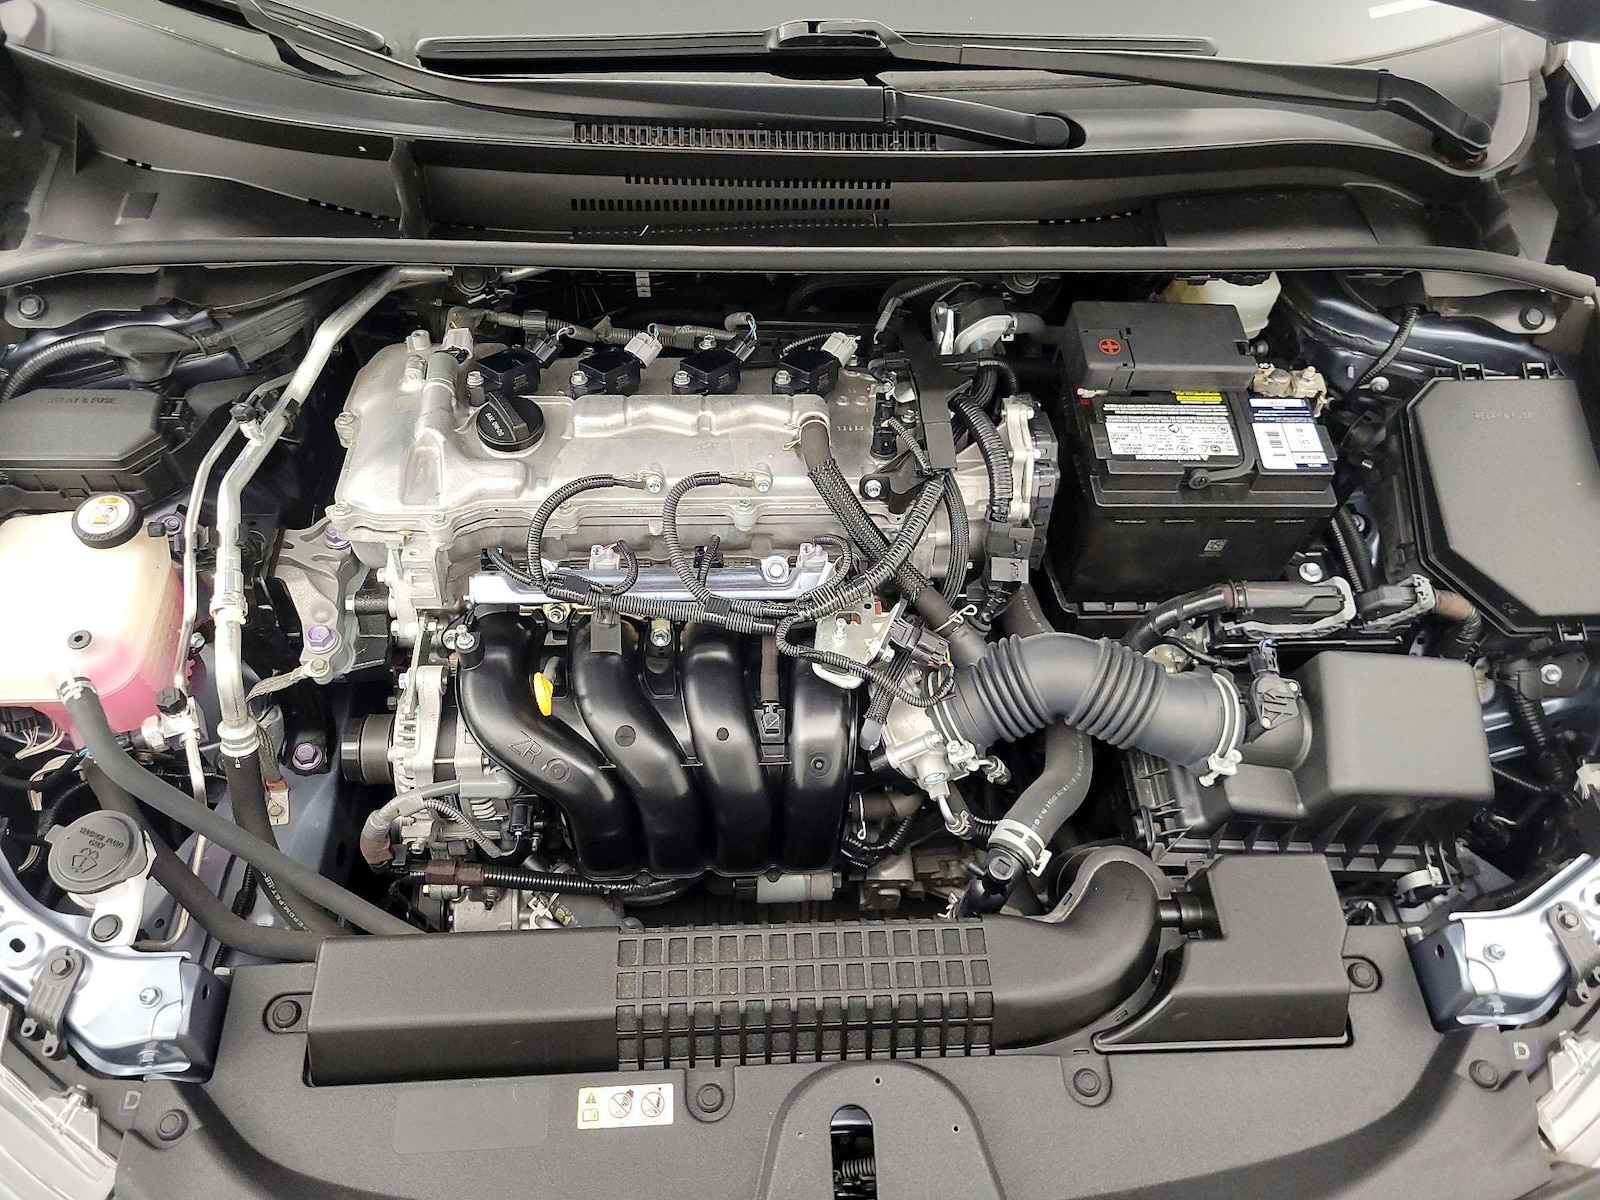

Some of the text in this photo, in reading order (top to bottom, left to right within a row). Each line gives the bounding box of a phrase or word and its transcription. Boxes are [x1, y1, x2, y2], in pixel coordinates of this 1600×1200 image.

[485, 412, 496, 422] SAE
[508, 729, 543, 765] ZR
[1512, 1041, 1531, 1060] D
[123, 1090, 142, 1110] D
